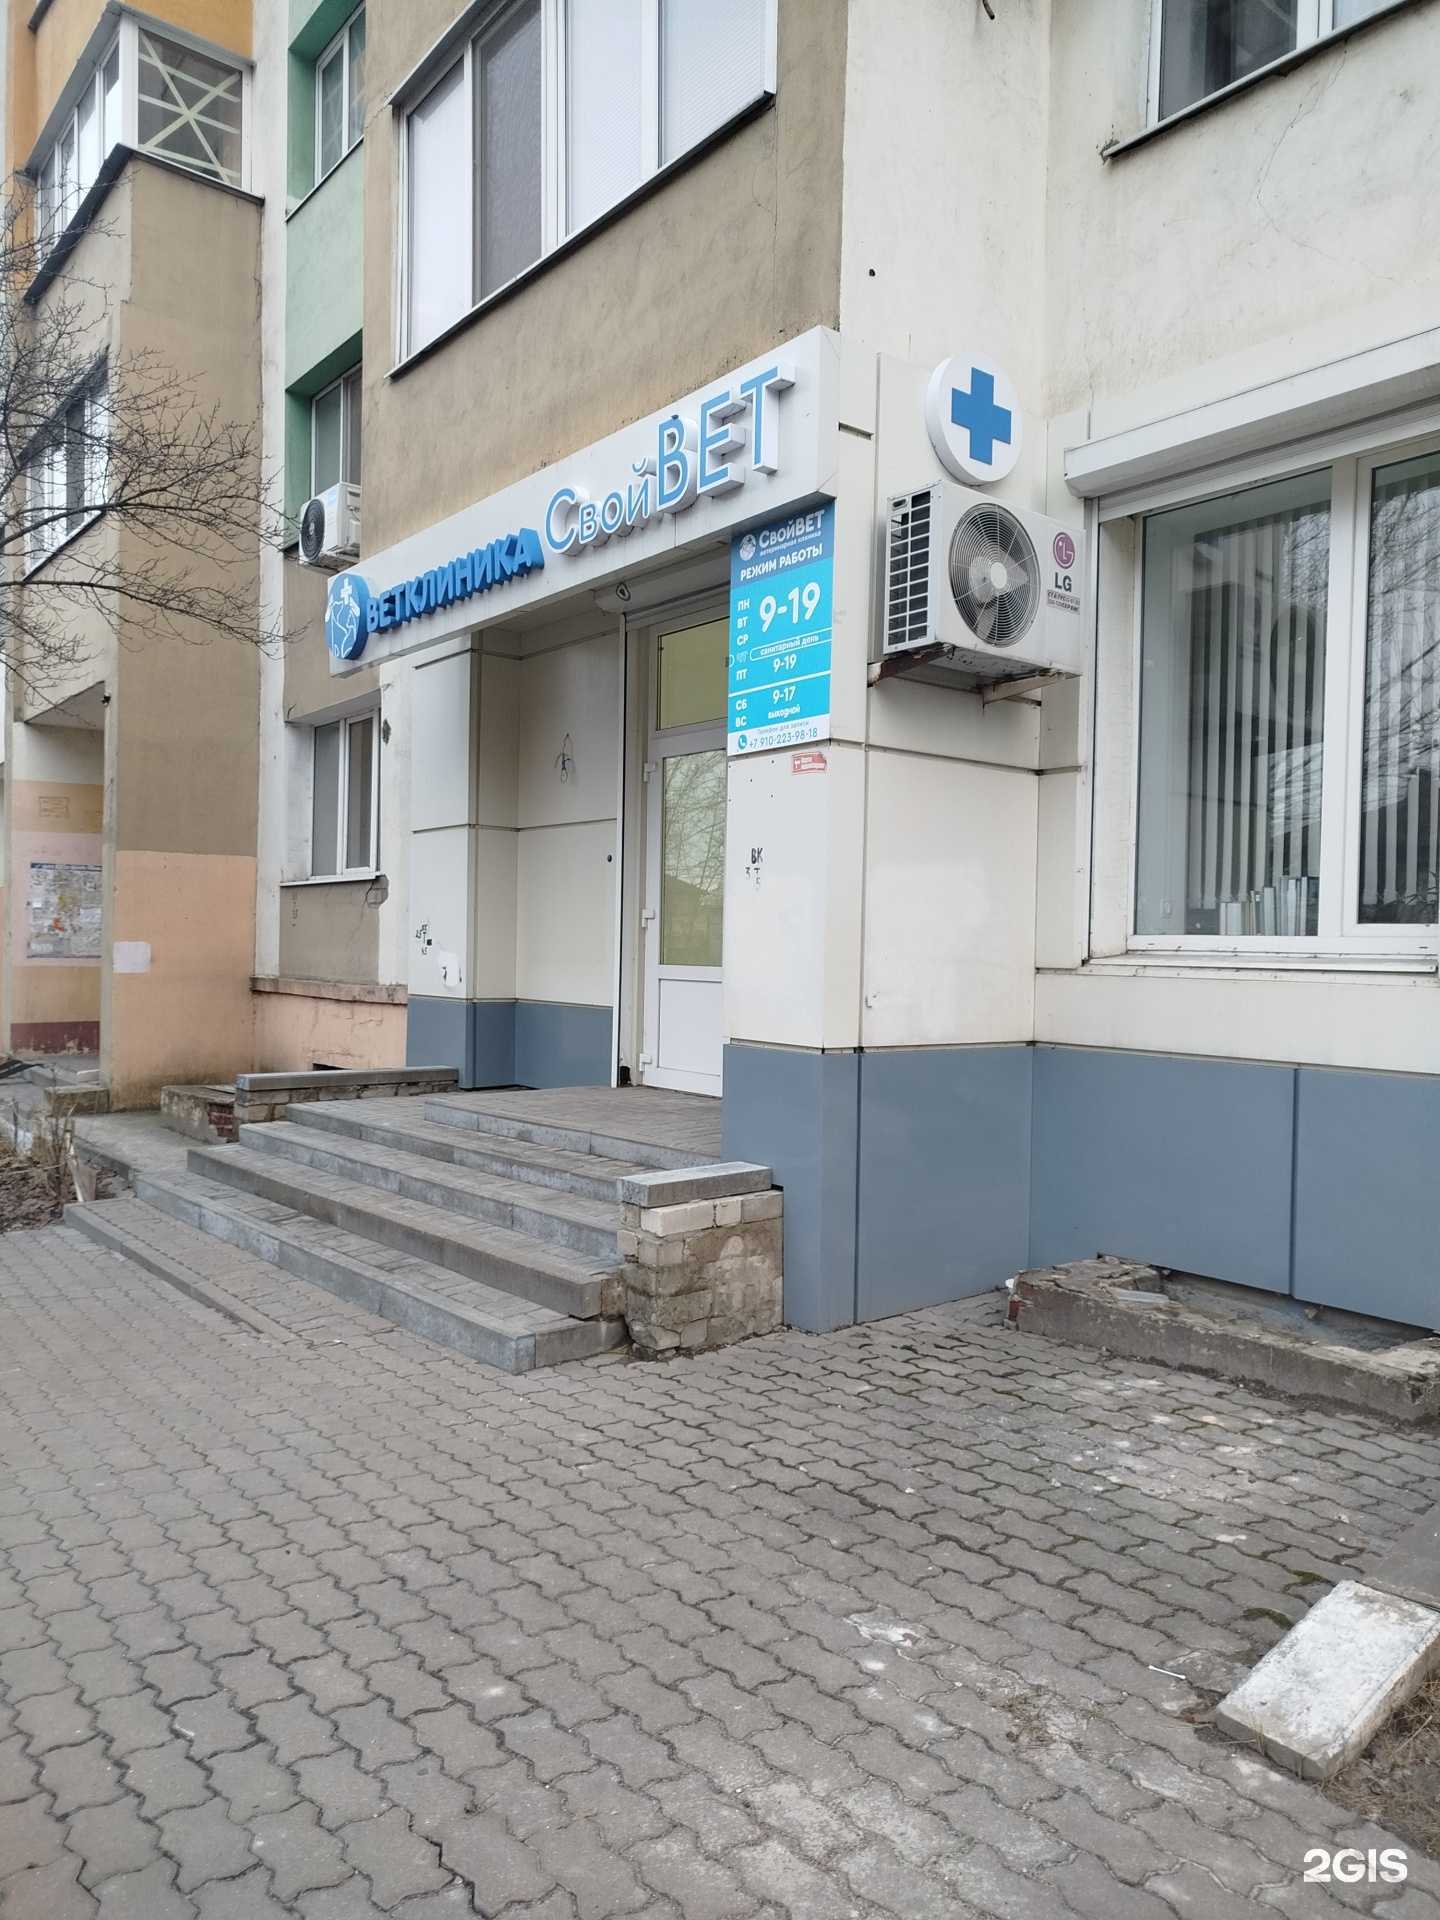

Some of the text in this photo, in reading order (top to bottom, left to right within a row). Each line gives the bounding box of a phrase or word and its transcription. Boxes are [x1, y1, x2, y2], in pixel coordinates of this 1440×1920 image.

[740, 543, 823, 581] РЕЖИМ РАБОТЫ
[366, 529, 543, 633] ВЕТКЛИНИКА
[1054, 571, 1072, 593] LG
[737, 598, 750, 612] ПН
[759, 582, 821, 633] 9-19
[737, 616, 748, 629] ВТ
[736, 634, 749, 646] СР
[773, 654, 797, 672] 9-19
[736, 669, 748, 681] ПТ
[772, 686, 796, 705] 9-17
[735, 715, 747, 728] ВС
